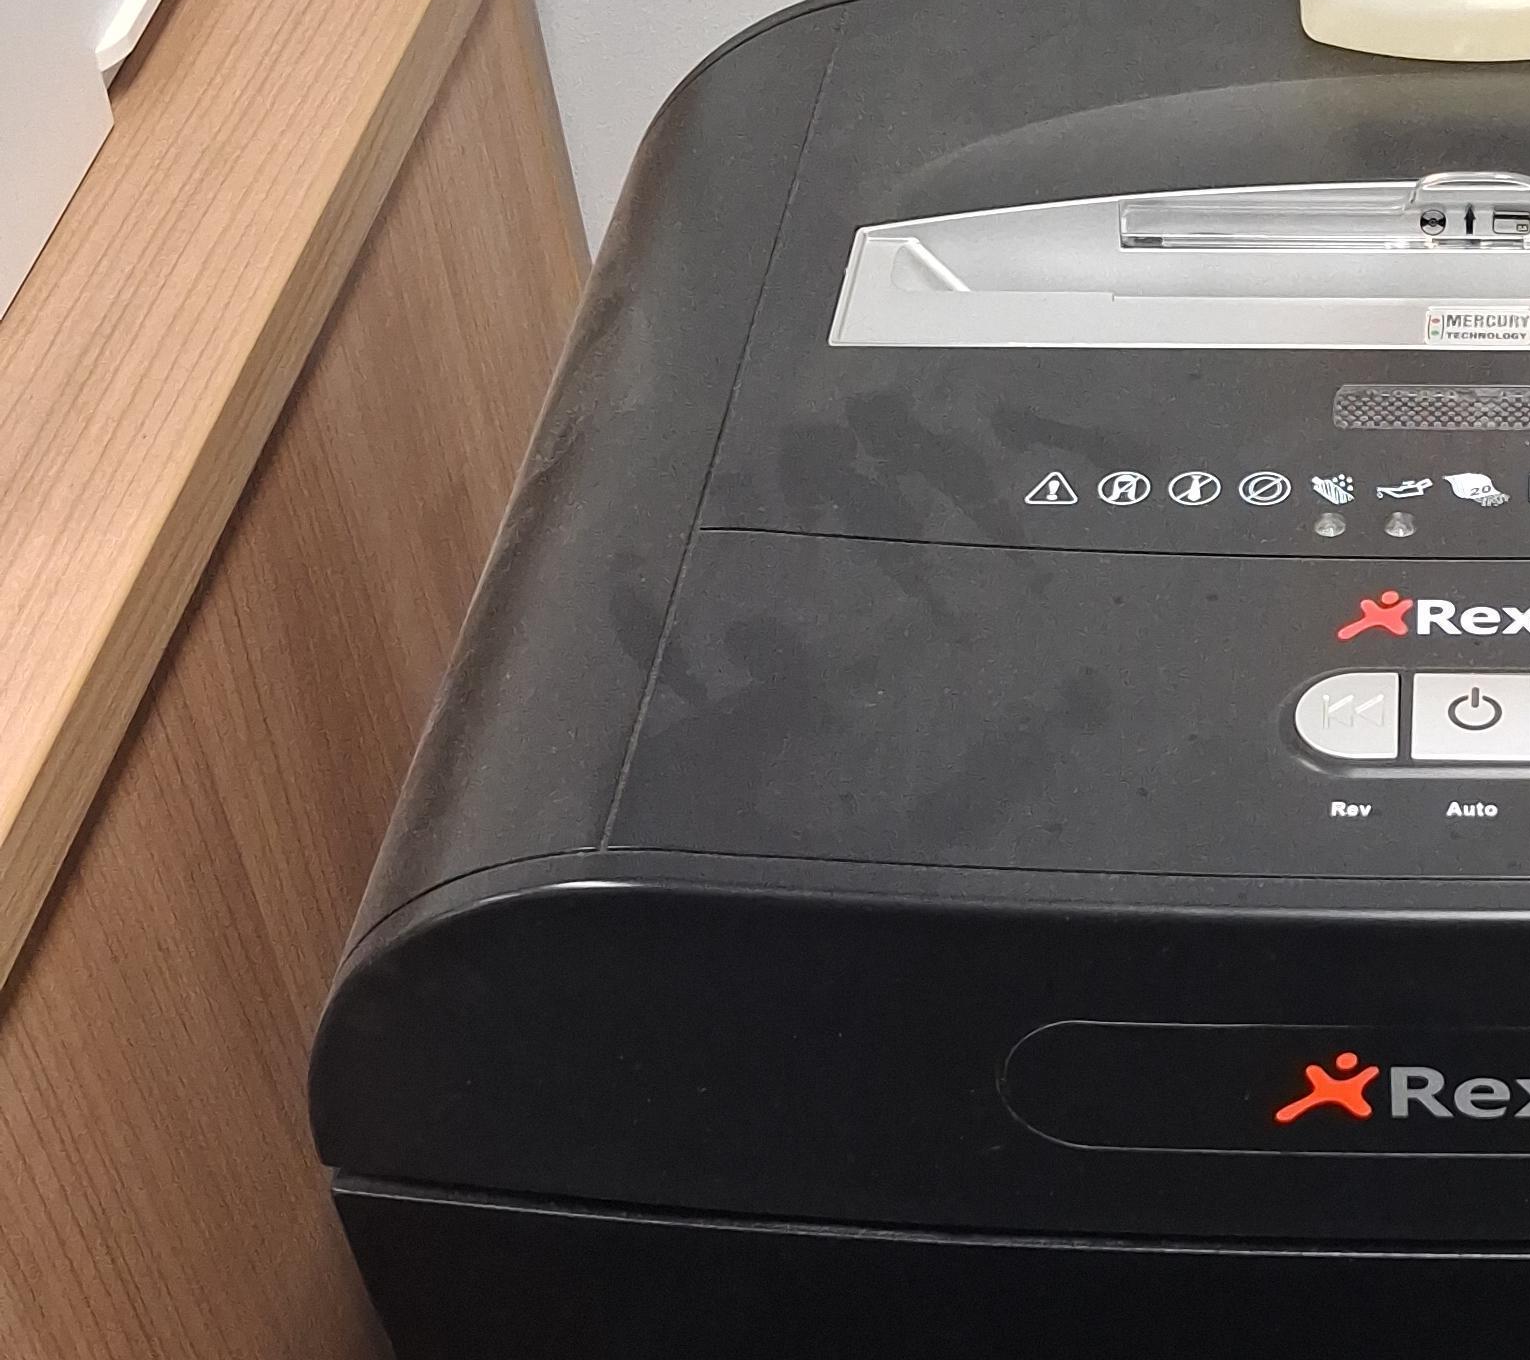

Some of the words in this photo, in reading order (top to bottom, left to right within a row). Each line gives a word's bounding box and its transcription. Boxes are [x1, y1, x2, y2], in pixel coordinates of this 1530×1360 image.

[1446, 314, 1530, 328] MERCURY
[1446, 332, 1527, 340] TECHNOLOGY
[1470, 485, 1492, 497] 20
[1331, 801, 1371, 817] Rev
[1446, 802, 1498, 818] Auto
